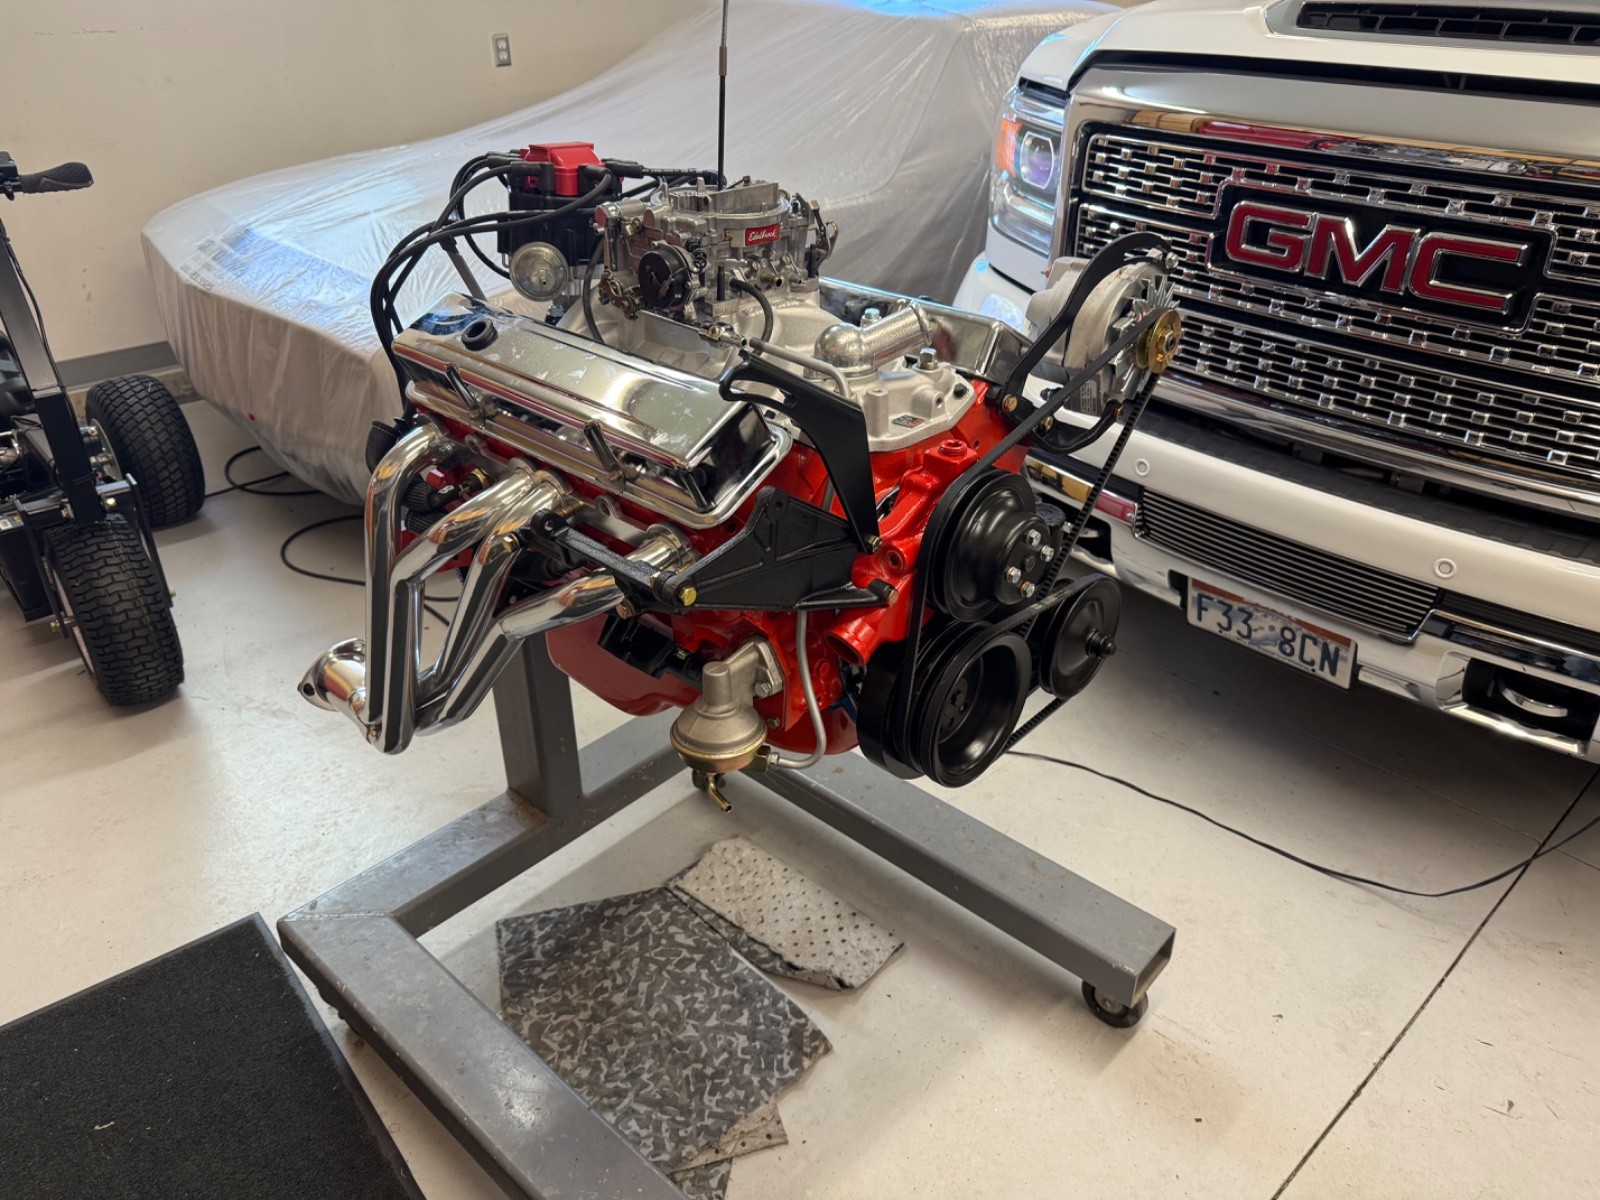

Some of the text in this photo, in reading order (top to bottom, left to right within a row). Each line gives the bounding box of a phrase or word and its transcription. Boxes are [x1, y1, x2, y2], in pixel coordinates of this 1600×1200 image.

[1226, 200, 1528, 315] GMC
[1196, 593, 1252, 639] F33
[1278, 626, 1340, 677] 8CN
